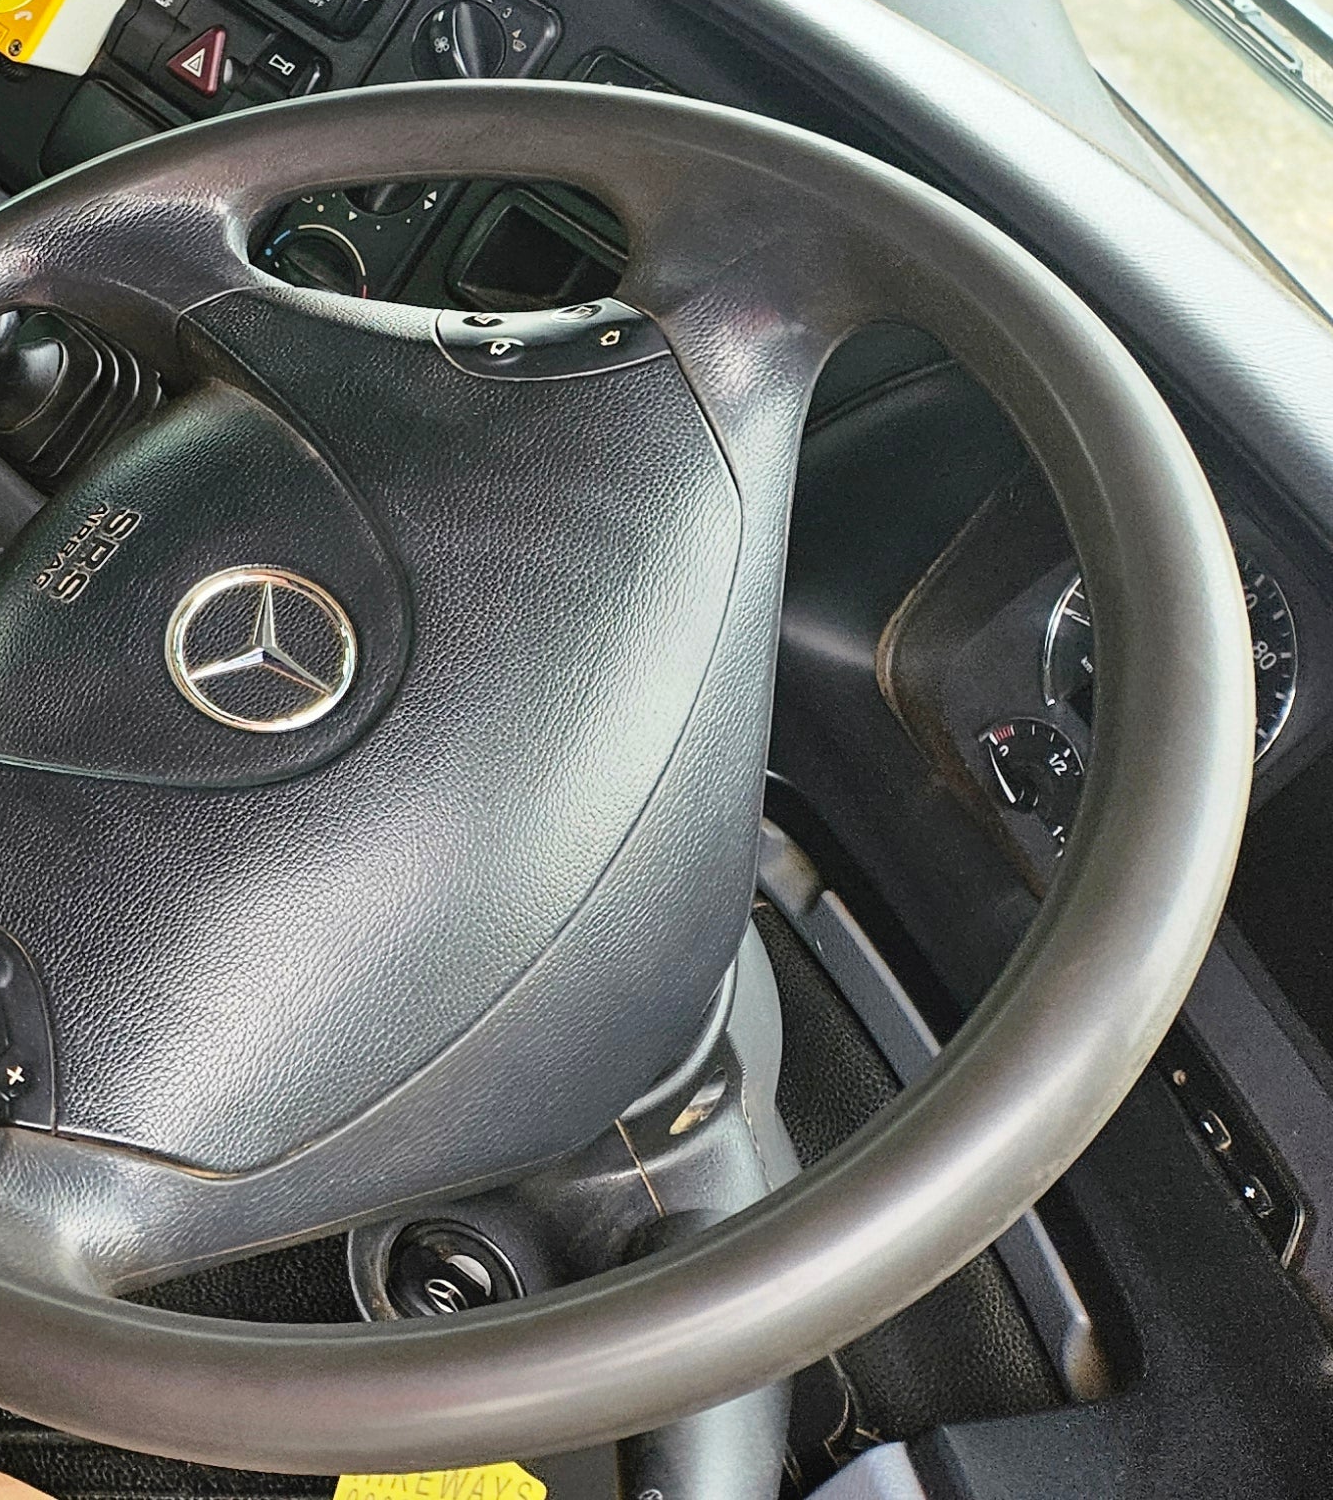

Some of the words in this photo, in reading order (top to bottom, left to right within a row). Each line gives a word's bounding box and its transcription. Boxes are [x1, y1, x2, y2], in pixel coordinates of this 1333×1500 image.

[502, 7, 513, 19] 3
[32, 502, 111, 591] AIRBAG
[49, 508, 142, 605] SRS
[1252, 640, 1277, 671] 80
